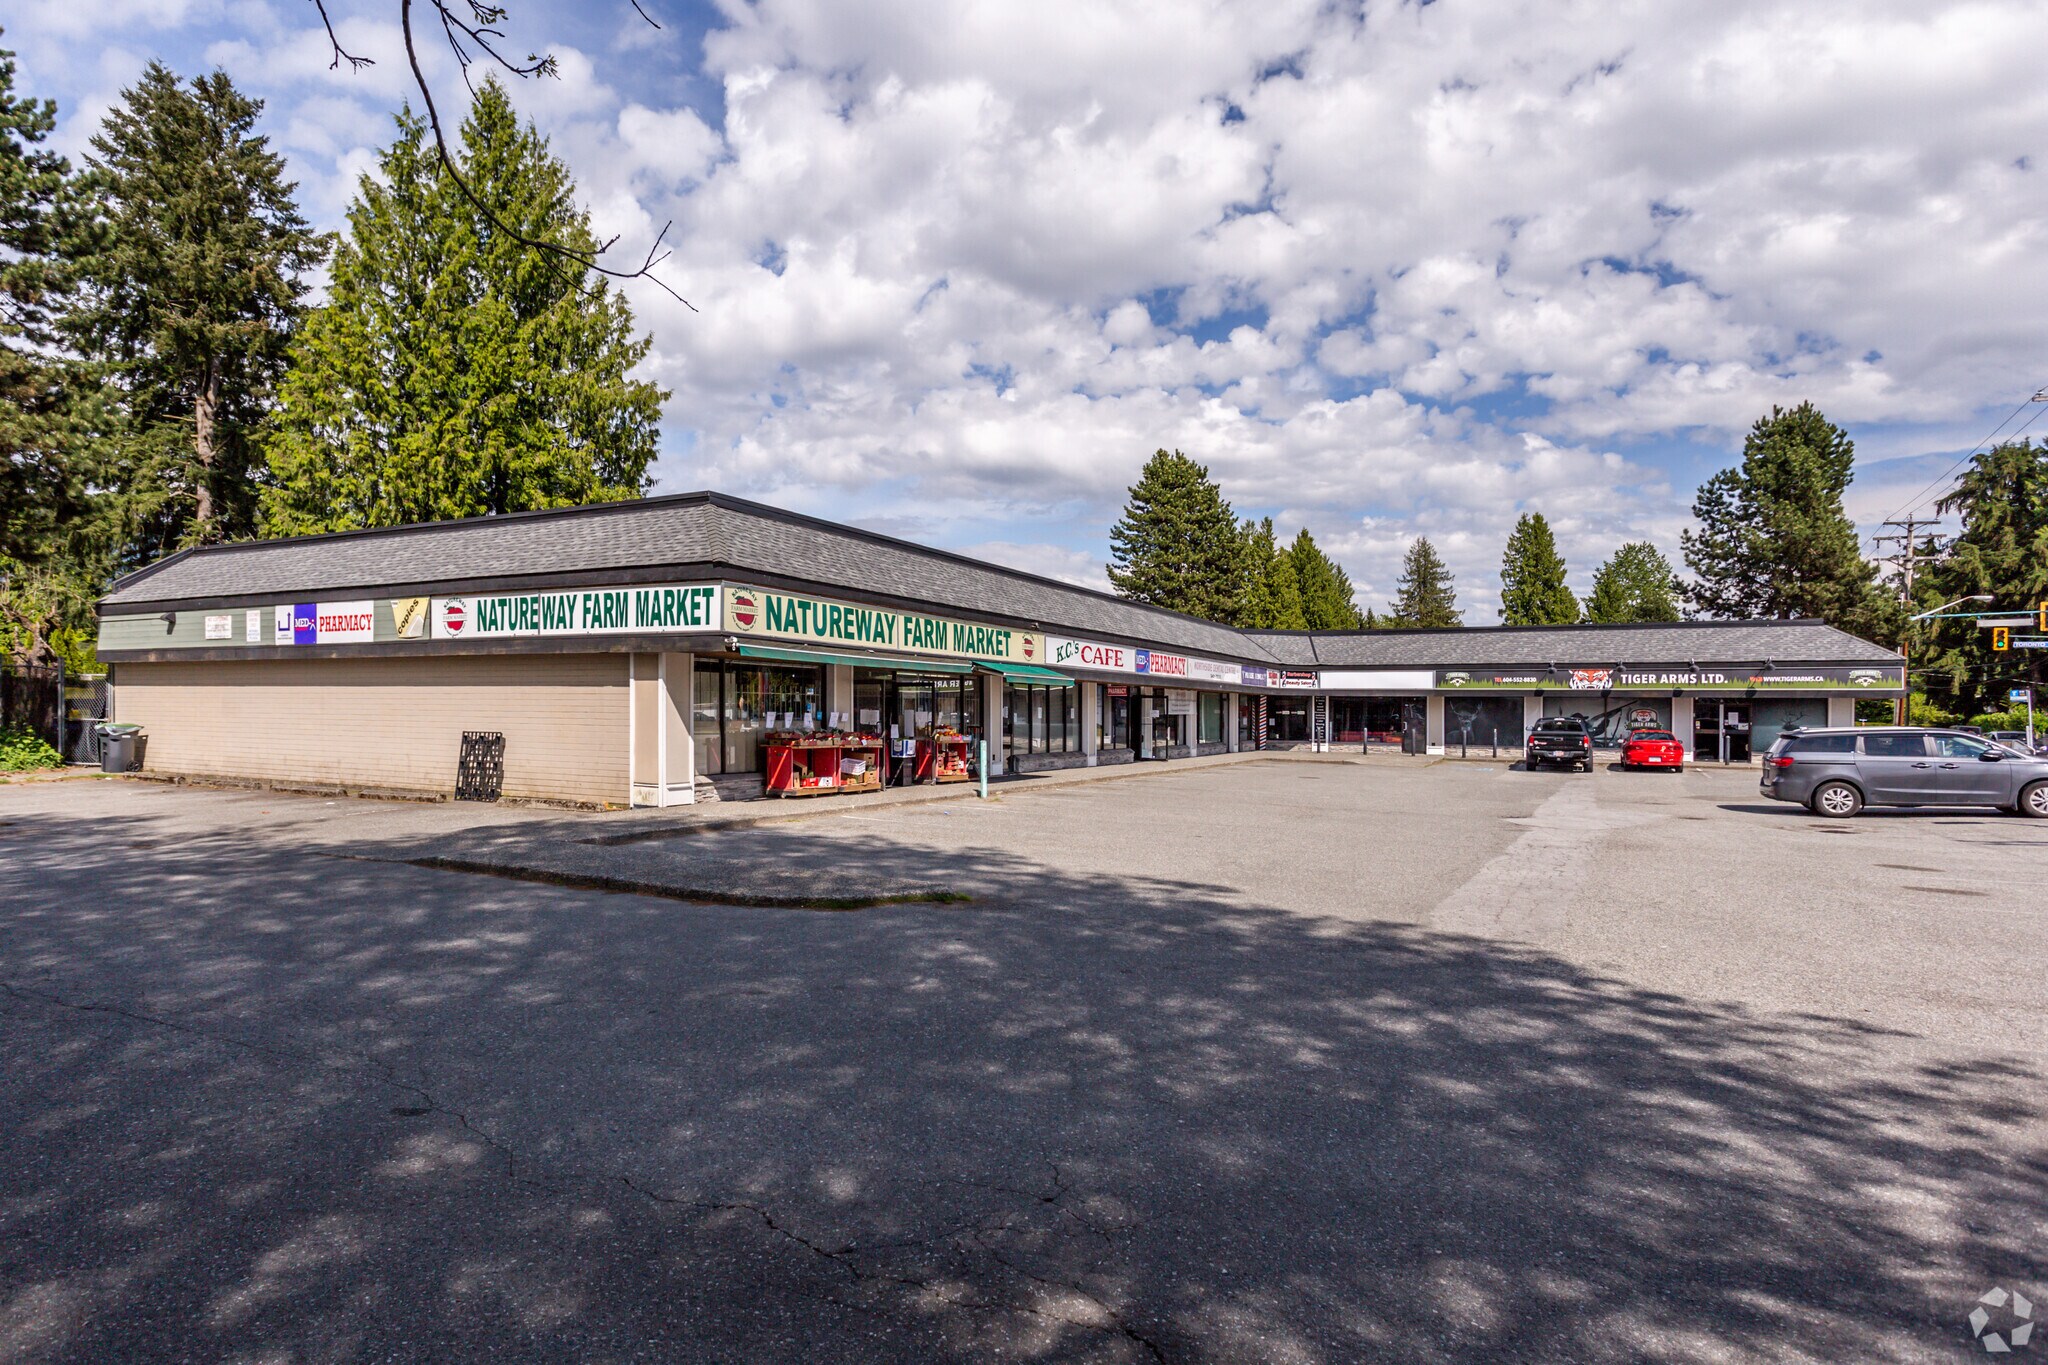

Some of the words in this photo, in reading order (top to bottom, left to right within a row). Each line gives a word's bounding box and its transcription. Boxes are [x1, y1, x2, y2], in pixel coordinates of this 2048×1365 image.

[397, 599, 419, 634] copies
[477, 595, 577, 632] NATUREWAY
[582, 592, 628, 628] FARM
[635, 587, 714, 627] MARKET
[319, 614, 373, 632] PHARMACY
[765, 595, 897, 645] NATUREWAY
[904, 616, 948, 649] FARM
[953, 623, 1012, 657] MARKET
[1081, 645, 1124, 668] CAFE
[1150, 653, 1186, 676] PHARMACY
[1620, 674, 1656, 684] TIGER
[1660, 674, 1697, 684] ARMS
[1701, 674, 1728, 684] LTD.
